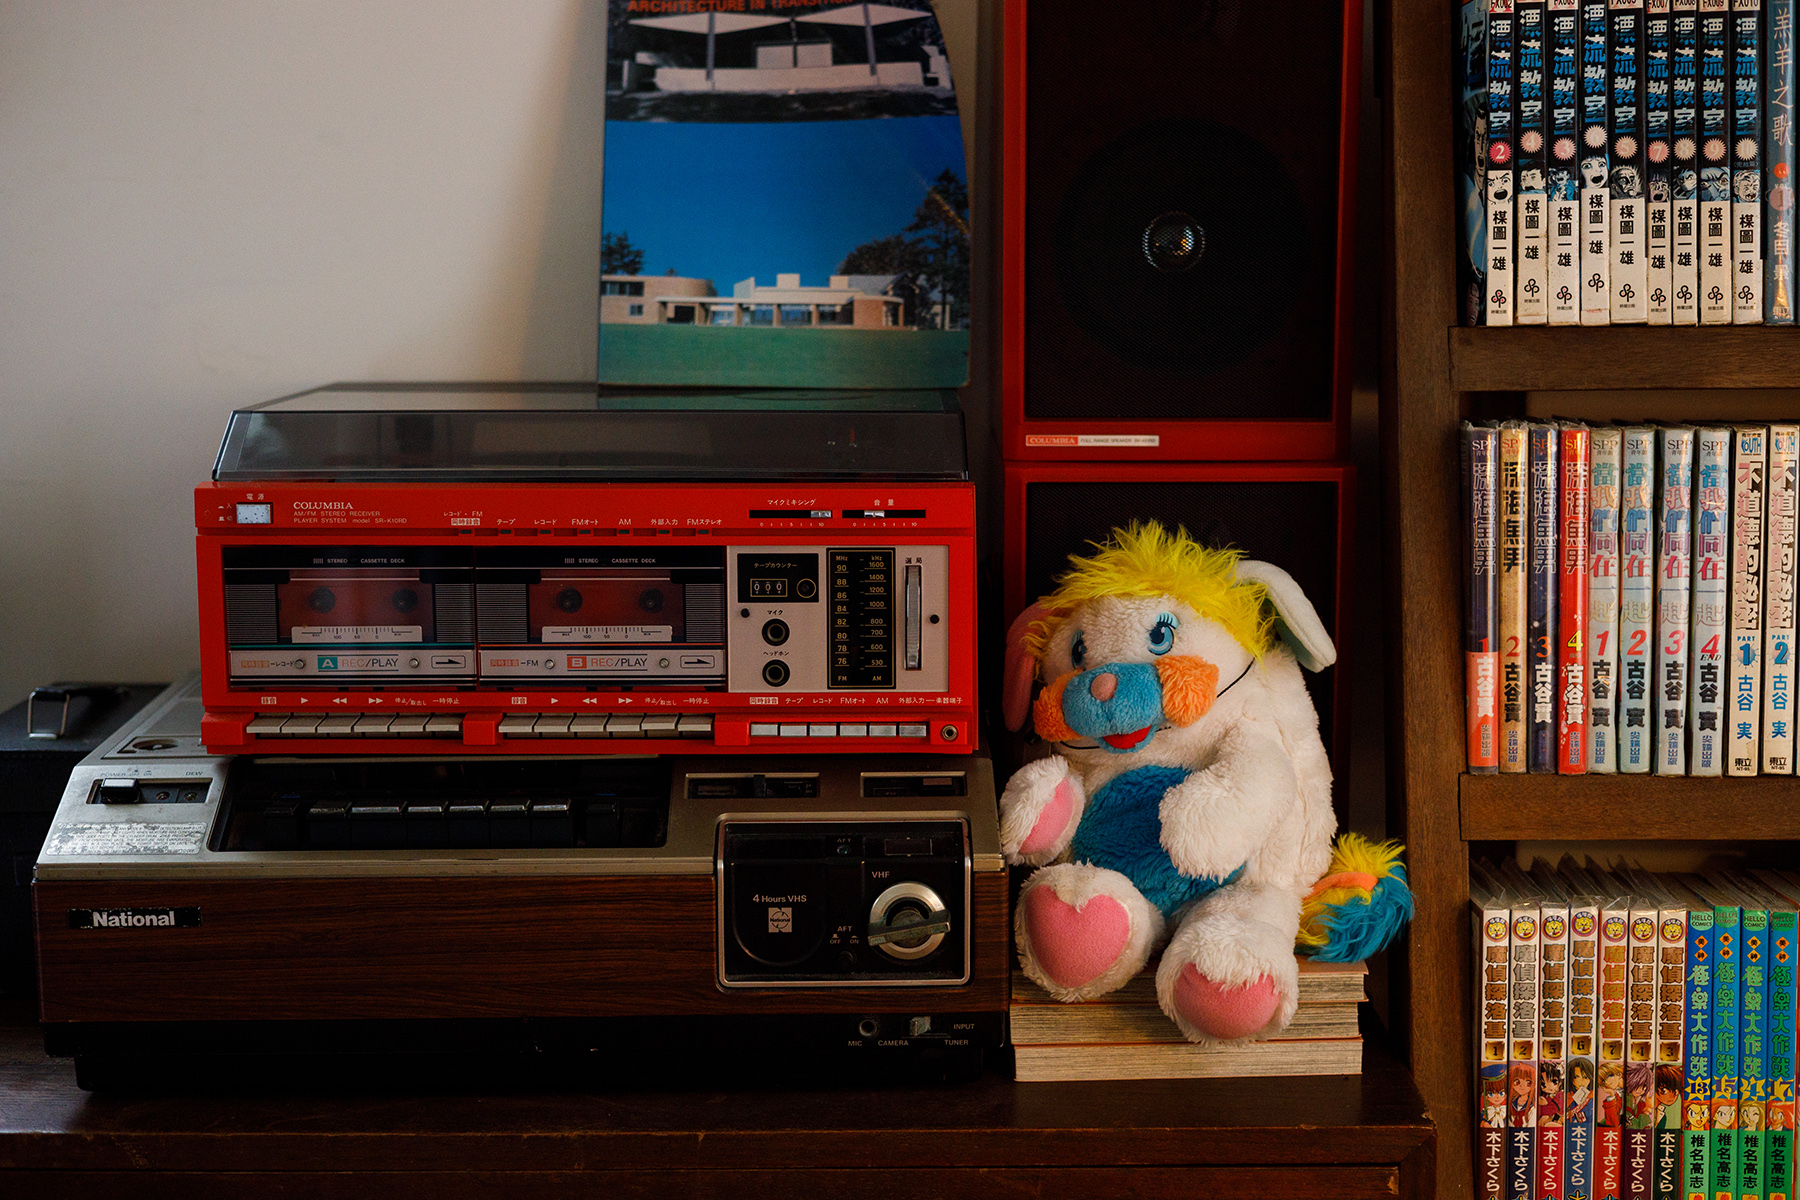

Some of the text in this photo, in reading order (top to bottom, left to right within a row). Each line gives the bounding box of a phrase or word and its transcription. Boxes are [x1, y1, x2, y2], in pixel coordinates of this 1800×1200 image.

[627, 0, 765, 12] ARCHITECTURE IN
[1519, 8, 1543, 128] 漂流教室
[1553, 16, 1576, 135] 漂流教室
[1584, 4, 1606, 123] 漂流教室
[1613, 15, 1637, 134] 漂流教室
[1673, 16, 1696, 135] 漂流教室
[1489, 19, 1512, 138] 漂流教室
[1647, 19, 1669, 138] 漂流教室
[1702, 17, 1725, 136] 漂流教室
[1735, 17, 1758, 136] 漂流教室
[1771, 7, 1794, 147] 羔羊之歌
[1525, 133, 1536, 149] 4
[1560, 140, 1571, 156] 3
[1590, 129, 1601, 144] 6
[1620, 140, 1631, 155] 5
[1680, 141, 1690, 156] 8
[1495, 144, 1506, 160] 2
[1652, 145, 1663, 160] 7
[1709, 142, 1720, 157] 9
[1740, 142, 1755, 157] 10
[1524, 199, 1540, 260] 楳圖一雄
[1557, 206, 1573, 267] 楳圖一雄
[1589, 194, 1604, 255] 楳圖一雄
[1619, 204, 1635, 265] 楳圖一雄
[1677, 206, 1693, 267] 楳圖一雄
[1492, 210, 1508, 271] 楳圖一雄
[1651, 209, 1666, 270] 楳圖一雄
[1708, 207, 1723, 268] 楳圖一雄
[1739, 213, 1755, 275] 楳圖一雄
[1471, 439, 1497, 451] SPP
[1565, 439, 1589, 450] SPP
[1592, 439, 1619, 450] SPP
[1626, 439, 1652, 450] SPP
[1667, 439, 1693, 450] SPP
[1701, 440, 1727, 451] SPP
[293, 501, 354, 510] COLUMBIA
[767, 498, 817, 506] マイクミキシング
[1473, 461, 1497, 576] 深海魚男
[1503, 461, 1526, 574] 深海魚男
[1533, 461, 1557, 576] 深海魚男
[1565, 461, 1588, 575] 深海魚男
[836, 564, 847, 572] 90
[836, 578, 847, 586] 88
[836, 591, 847, 599] 86
[836, 618, 847, 626] 82
[836, 632, 847, 640] 80
[1478, 636, 1489, 653] 1
[1505, 635, 1520, 658] 2
[1536, 635, 1553, 658] 3
[1567, 629, 1584, 652] 4
[1596, 630, 1610, 656] 1
[1626, 629, 1648, 656] 2
[1664, 629, 1686, 656] 3
[1700, 633, 1721, 658] 4
[321, 658, 399, 668] A REC/PLAY
[571, 657, 648, 667] B REC/PLAY
[836, 657, 847, 665] 76
[1739, 643, 1751, 666] 1
[1774, 641, 1788, 665] 2
[752, 894, 807, 903] 4 Hours VHS
[92, 910, 175, 928] National
[1690, 1081, 1708, 1095] 13
[1715, 1078, 1737, 1093] 15
[1769, 1080, 1794, 1097] 17
[1485, 1131, 1502, 1192] 木下さくら
[1513, 1130, 1530, 1191] 木下さくら
[1542, 1130, 1559, 1191] 木下さくら
[1571, 1125, 1587, 1186] 木下さくら
[1602, 1130, 1619, 1190] 木下さくら
[1630, 1132, 1647, 1193] 木下さくら
[1659, 1132, 1676, 1193] 木下さくら
[1689, 1134, 1706, 1189] 椎名高志
[1716, 1132, 1732, 1188] 椎名高志
[1743, 1134, 1759, 1189] 椎名高志
[1770, 1135, 1787, 1189] 椎名高志
